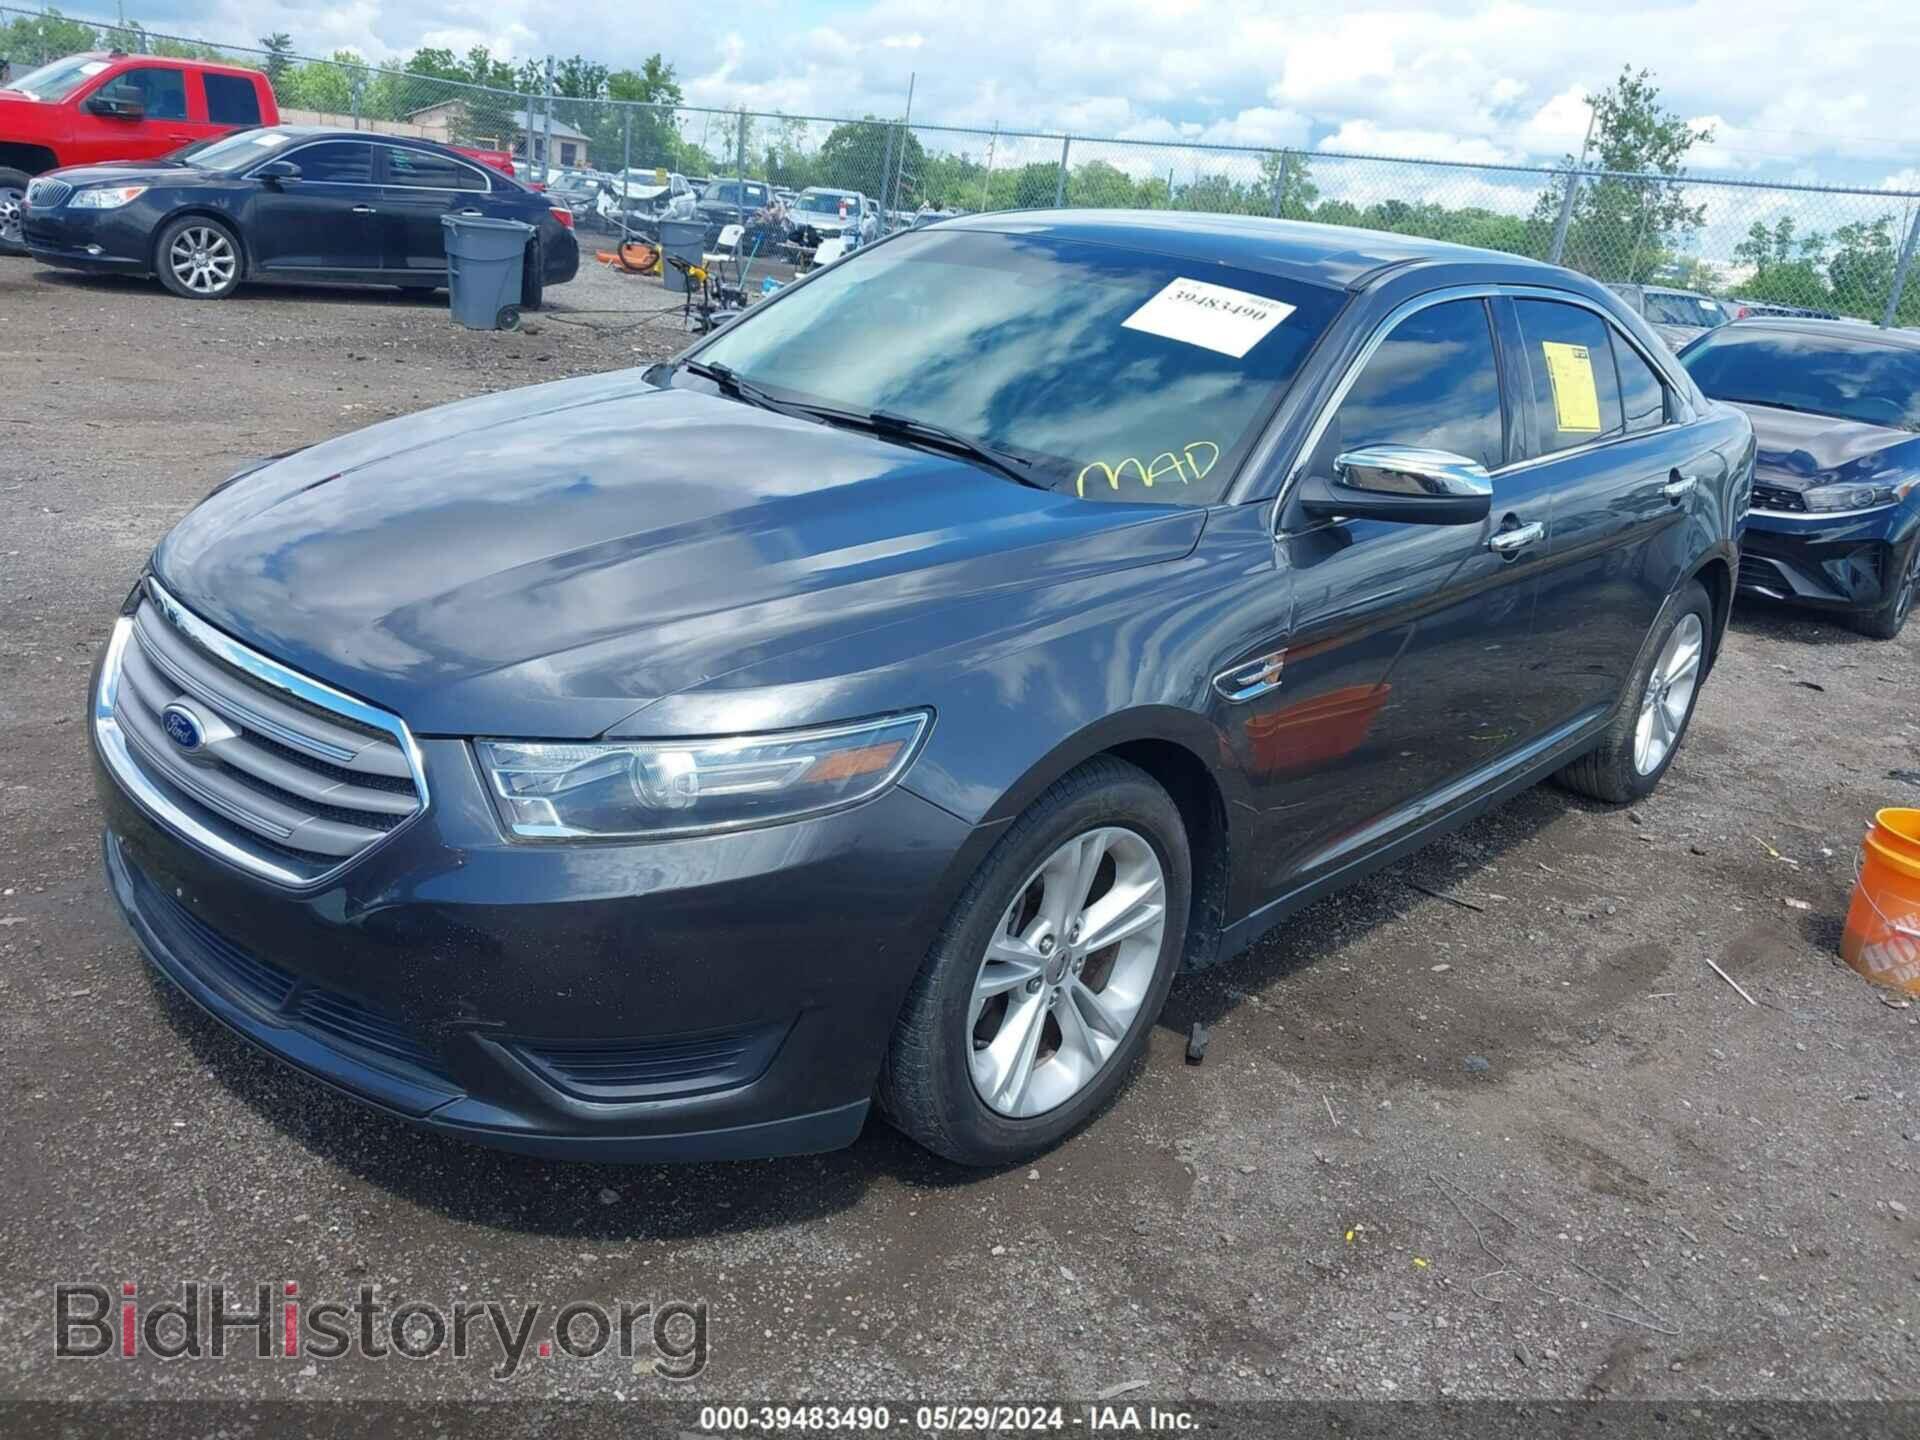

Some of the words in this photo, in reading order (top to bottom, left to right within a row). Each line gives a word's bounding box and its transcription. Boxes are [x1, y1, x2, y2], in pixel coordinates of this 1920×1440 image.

[1168, 289, 1267, 321] 39483490
[1076, 440, 1220, 499] MAD
[166, 713, 193, 745] Ford
